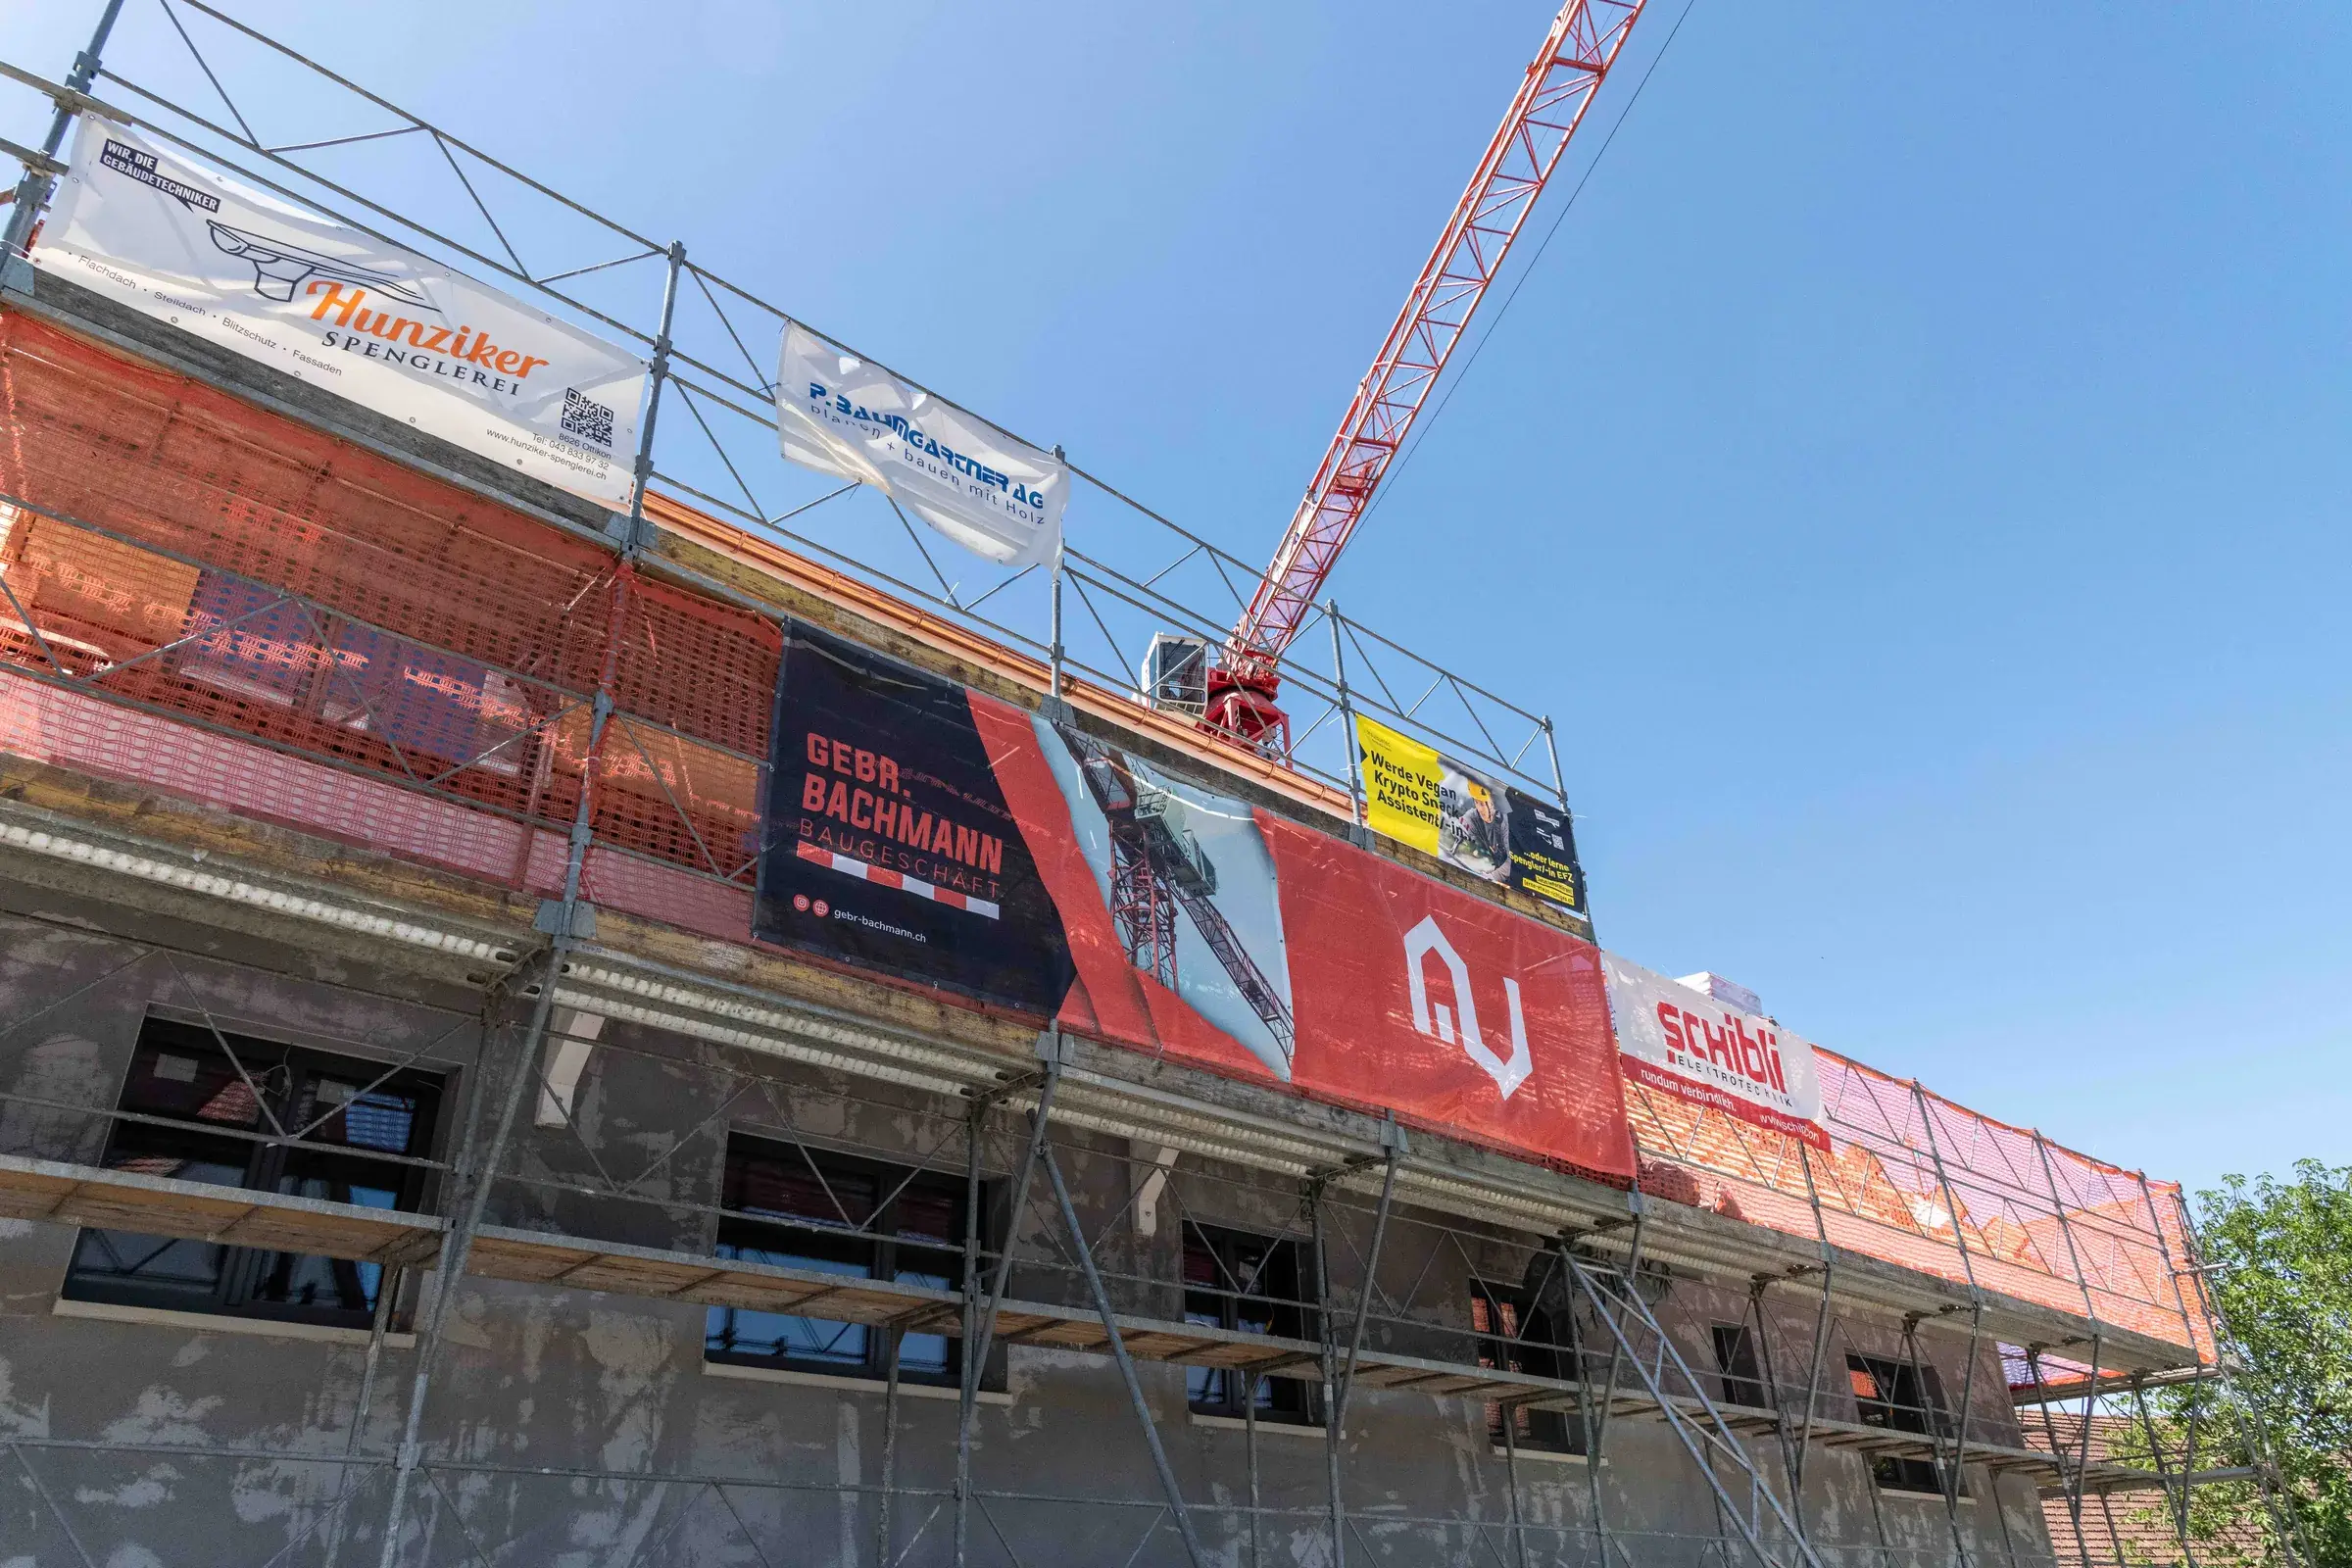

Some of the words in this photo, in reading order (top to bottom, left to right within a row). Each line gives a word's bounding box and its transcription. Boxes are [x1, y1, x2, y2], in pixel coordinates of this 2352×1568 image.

[107, 141, 132, 163] WIR,
[134, 154, 156, 171] DIE
[103, 155, 218, 211] GEBÄUDETECHNIKER
[78, 255, 137, 290] Flachdach
[154, 291, 207, 317] Steildach
[222, 317, 277, 349] Blitzschutz
[293, 349, 342, 376] Fassaden
[306, 280, 551, 379] Hunziker
[321, 331, 520, 397] SPENGLEREI
[486, 428, 607, 480] www.hunziker-spenglerei.ch
[532, 432, 547, 446] Tel:
[549, 440, 565, 453] 043
[567, 447, 584, 461] 833
[585, 455, 597, 465] 97
[598, 460, 610, 470] 32
[559, 432, 580, 447] 8626
[582, 442, 612, 461] Ottikon
[905, 448, 959, 486] bauen
[969, 484, 998, 506] mit
[1006, 501, 1045, 524] Holz
[1012, 483, 1044, 510] AG
[807, 732, 911, 798] GEBR.
[1371, 750, 1413, 782] Werde
[1415, 772, 1456, 801] Vegan
[1374, 769, 1419, 801] Krypto
[1422, 792, 1459, 819] Snack
[802, 773, 1003, 874] BACHMANN
[800, 817, 1000, 898] BAUGESCHÄFT
[1509, 850, 1556, 878] Spengler/-in
[1548, 857, 1570, 871] lerne
[834, 907, 927, 944] gebr-bachmann.ch
[1641, 1068, 1679, 1092] rundum
